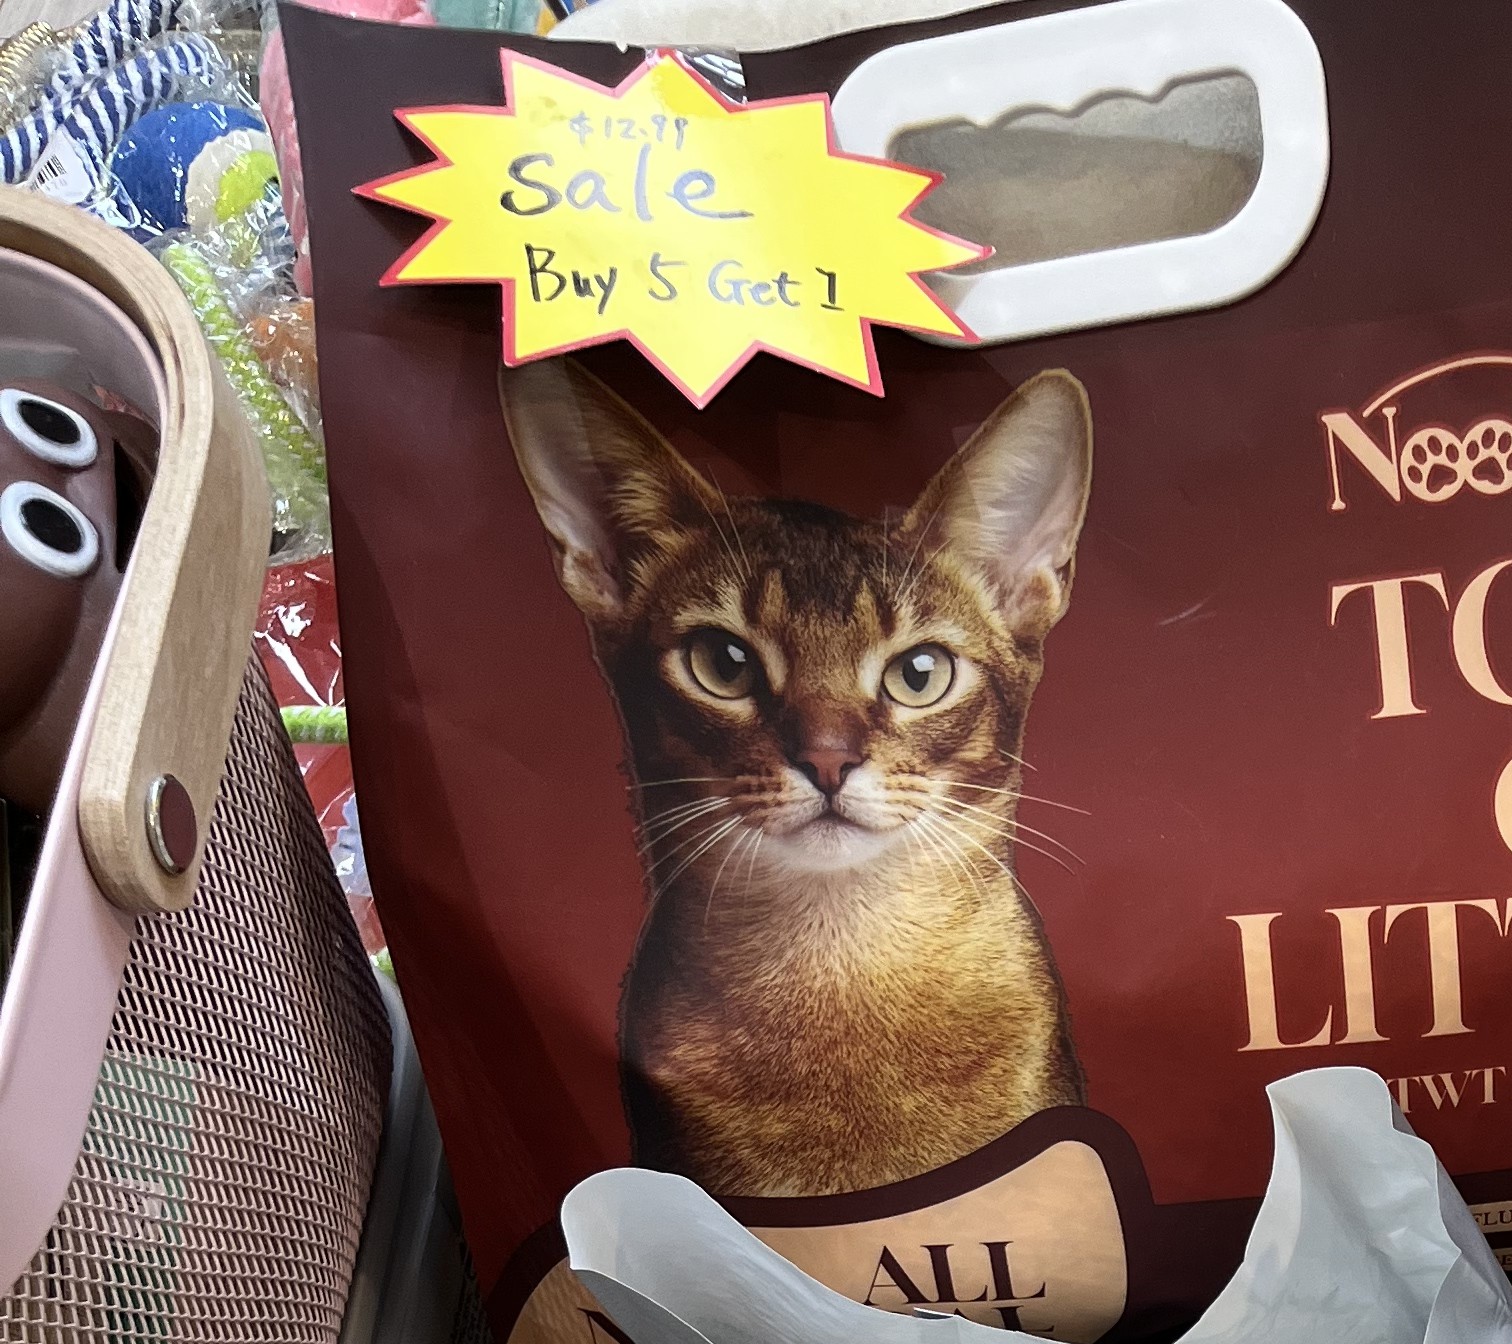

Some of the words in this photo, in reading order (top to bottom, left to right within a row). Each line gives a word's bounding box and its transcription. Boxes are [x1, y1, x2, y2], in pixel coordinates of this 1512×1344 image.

[500, 143, 755, 221] Sale
[524, 243, 618, 316] Buy
[648, 252, 688, 301] 5
[708, 259, 802, 307] Get
[864, 1240, 1046, 1307] ALL
